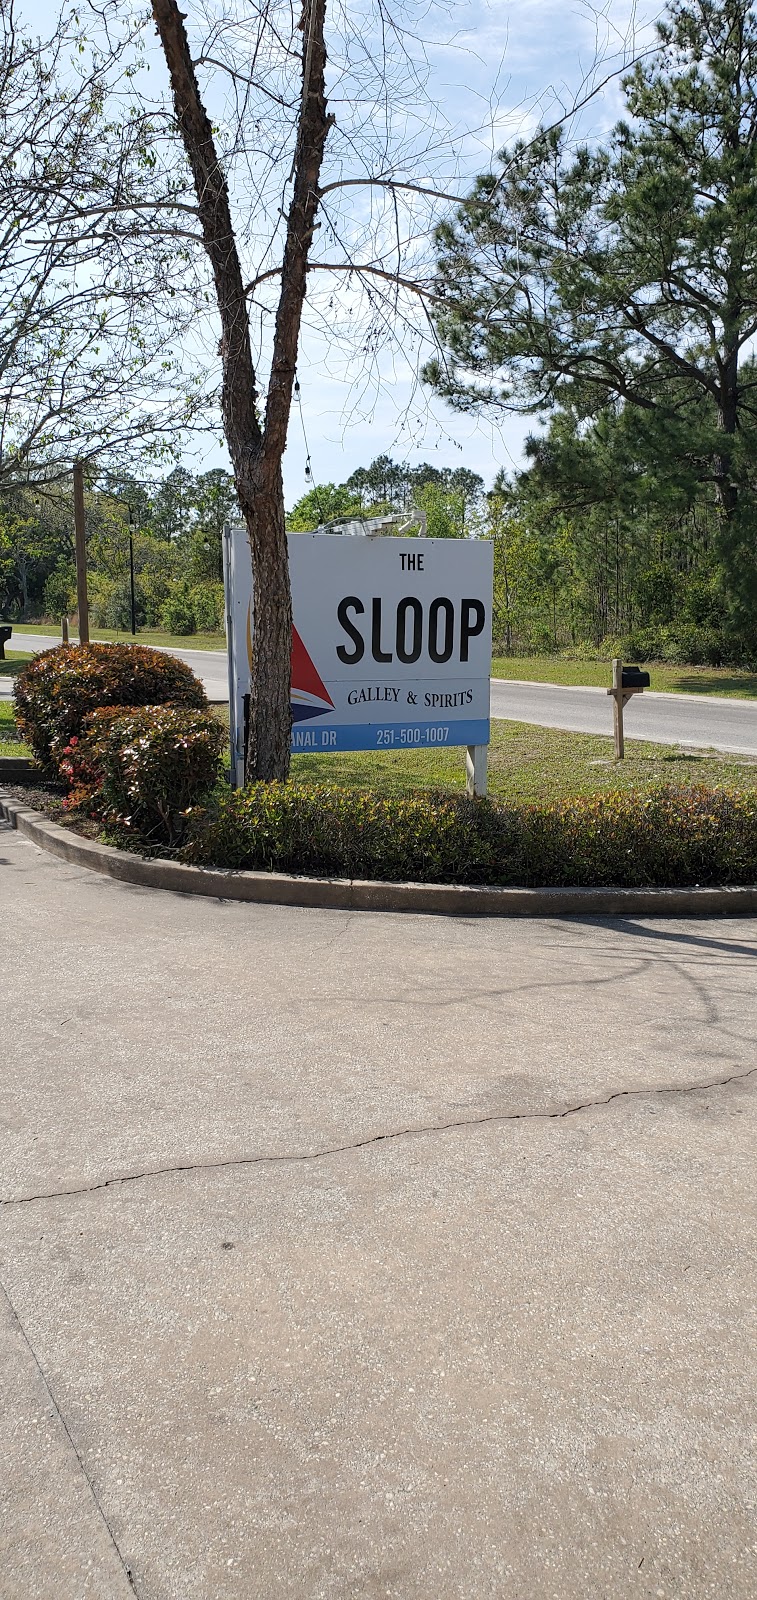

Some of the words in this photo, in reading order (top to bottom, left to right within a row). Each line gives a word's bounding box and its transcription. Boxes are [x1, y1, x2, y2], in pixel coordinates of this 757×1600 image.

[399, 553, 425, 571] THE
[336, 596, 486, 665] SLOOP
[347, 687, 401, 705] GALLEY
[406, 691, 419, 705] &
[424, 688, 473, 708] SPIRITS
[321, 730, 337, 746] DR
[376, 727, 450, 745] 251-500-1007
